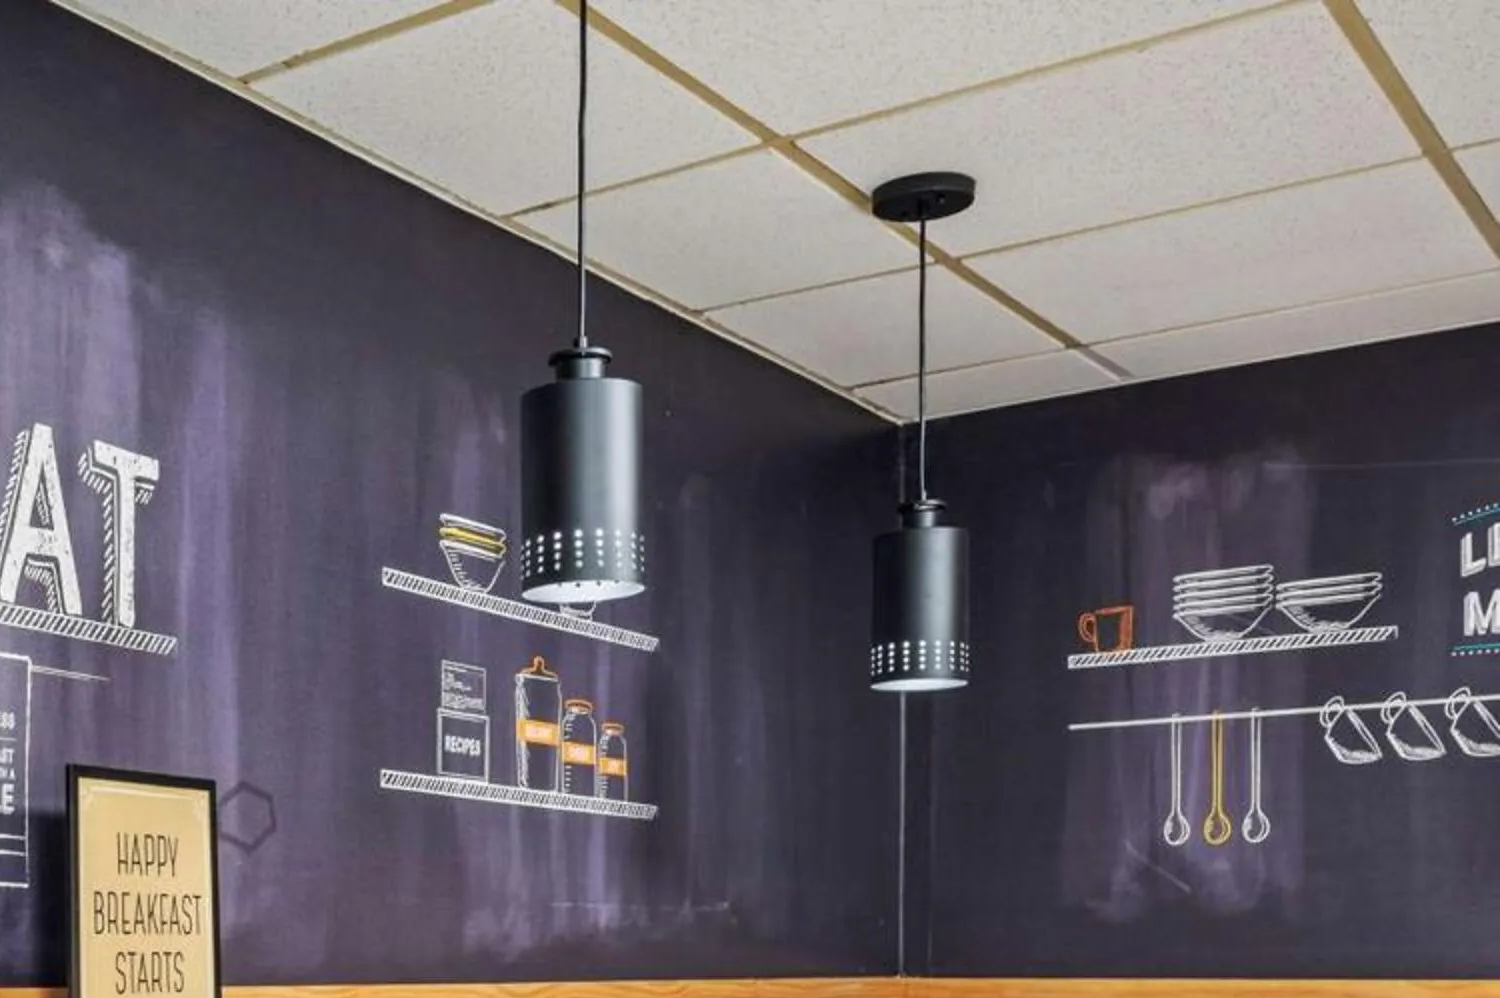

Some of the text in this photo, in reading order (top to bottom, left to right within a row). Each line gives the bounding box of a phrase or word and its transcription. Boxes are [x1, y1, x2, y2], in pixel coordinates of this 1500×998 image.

[444, 734, 481, 757] RECIPES
[115, 831, 179, 878] HAPPY
[93, 891, 203, 936] BREAKFAST
[115, 950, 186, 996] STARTS
